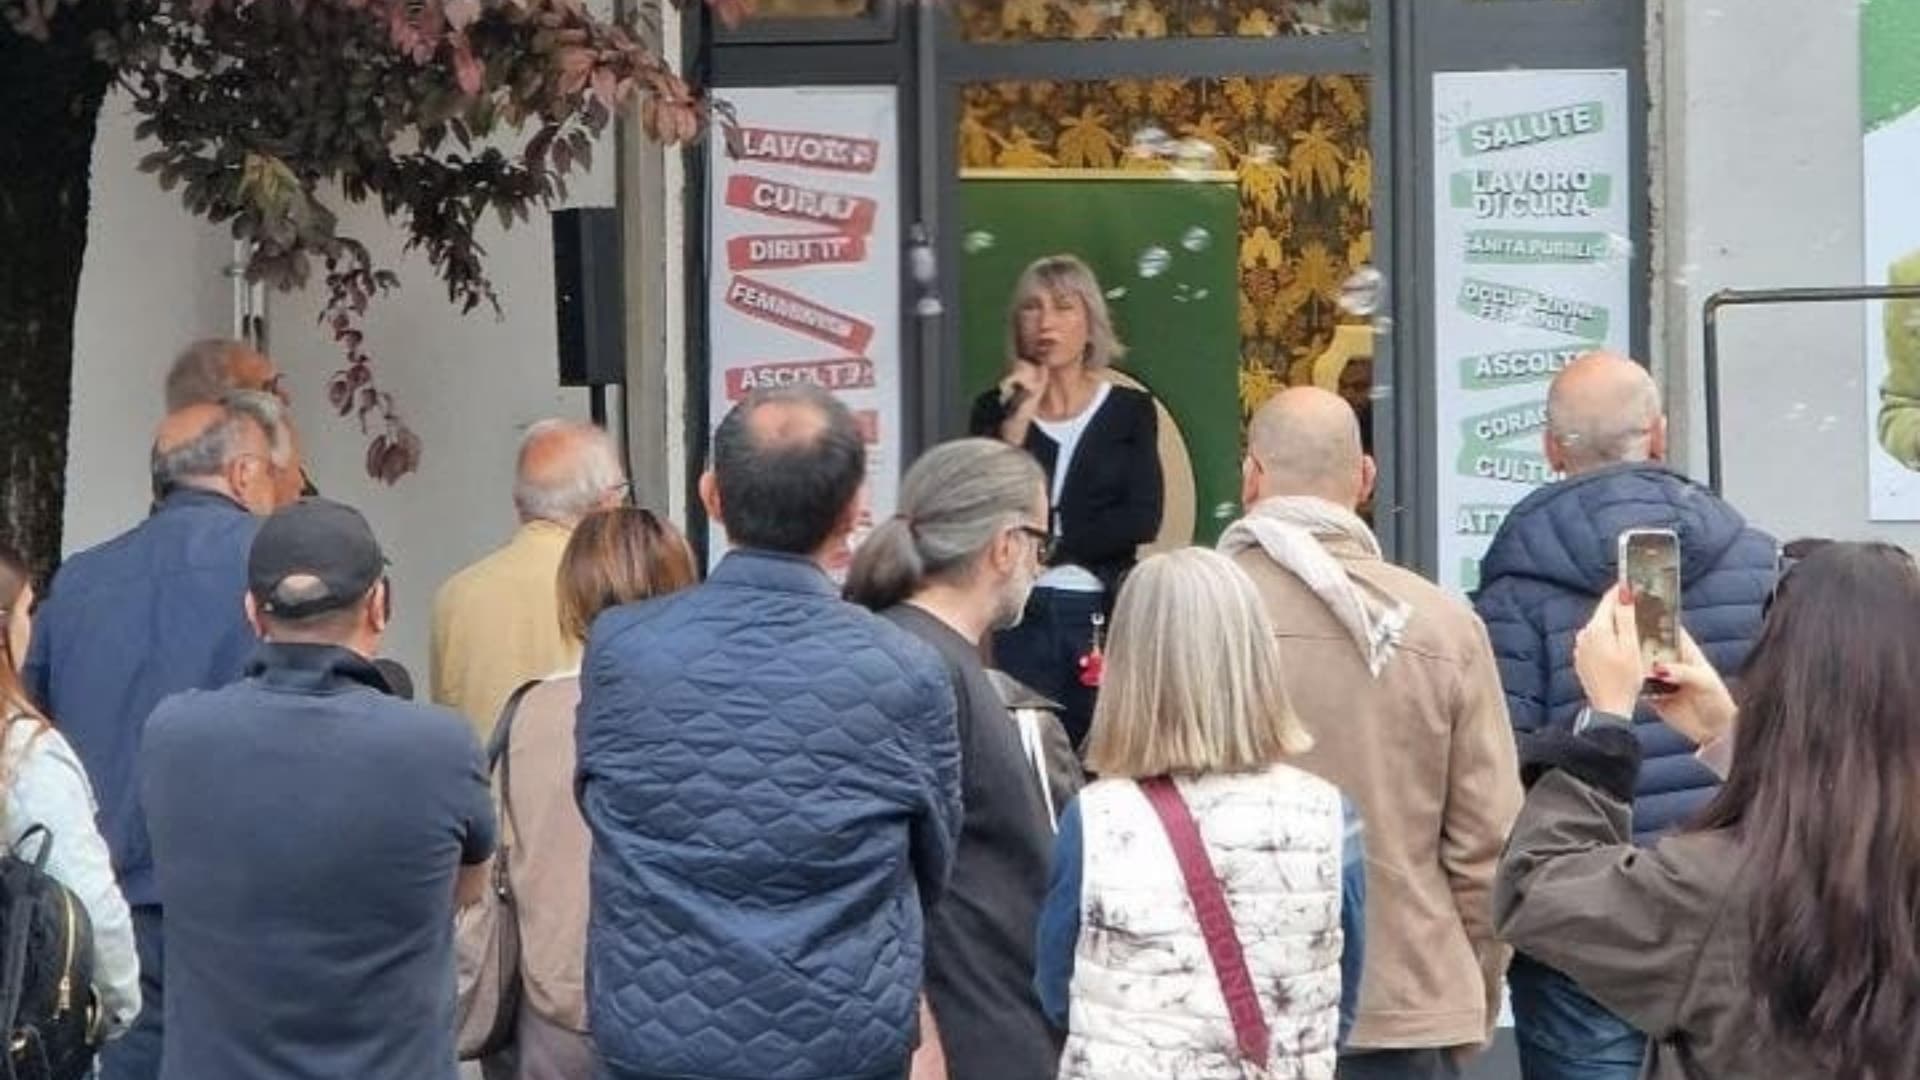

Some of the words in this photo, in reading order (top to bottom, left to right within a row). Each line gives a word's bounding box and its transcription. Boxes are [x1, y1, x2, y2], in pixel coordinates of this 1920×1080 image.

[1471, 104, 1594, 151] SALUTE
[1473, 168, 1591, 194] LAVORO
[1475, 194, 1504, 219] DI
[1509, 193, 1592, 218] CURA
